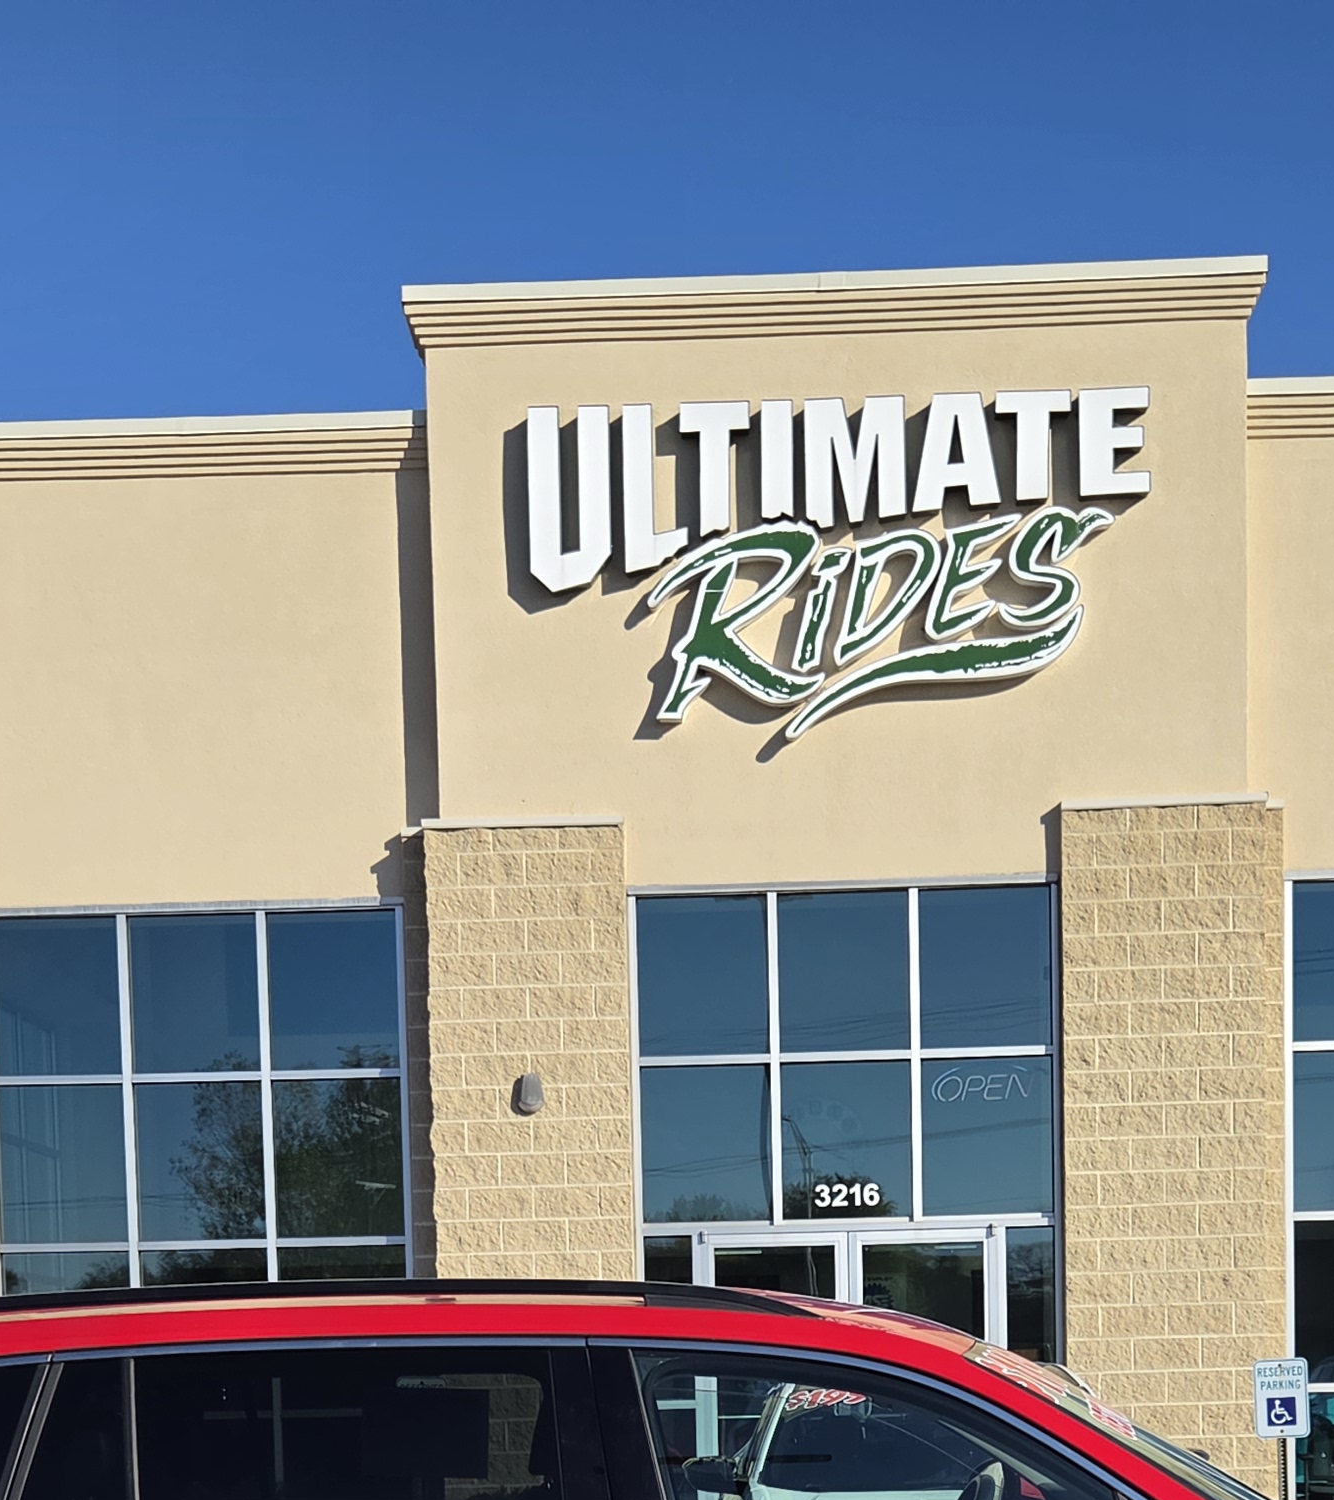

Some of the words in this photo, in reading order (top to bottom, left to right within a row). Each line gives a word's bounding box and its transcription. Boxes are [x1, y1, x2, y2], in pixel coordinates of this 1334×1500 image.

[527, 385, 1152, 594] ULTIMATE
[937, 1073, 1034, 1103] OPEN
[814, 1182, 881, 1208] 3216
[1257, 1366, 1303, 1378] RESERVED
[1260, 1379, 1302, 1391] PARKING
